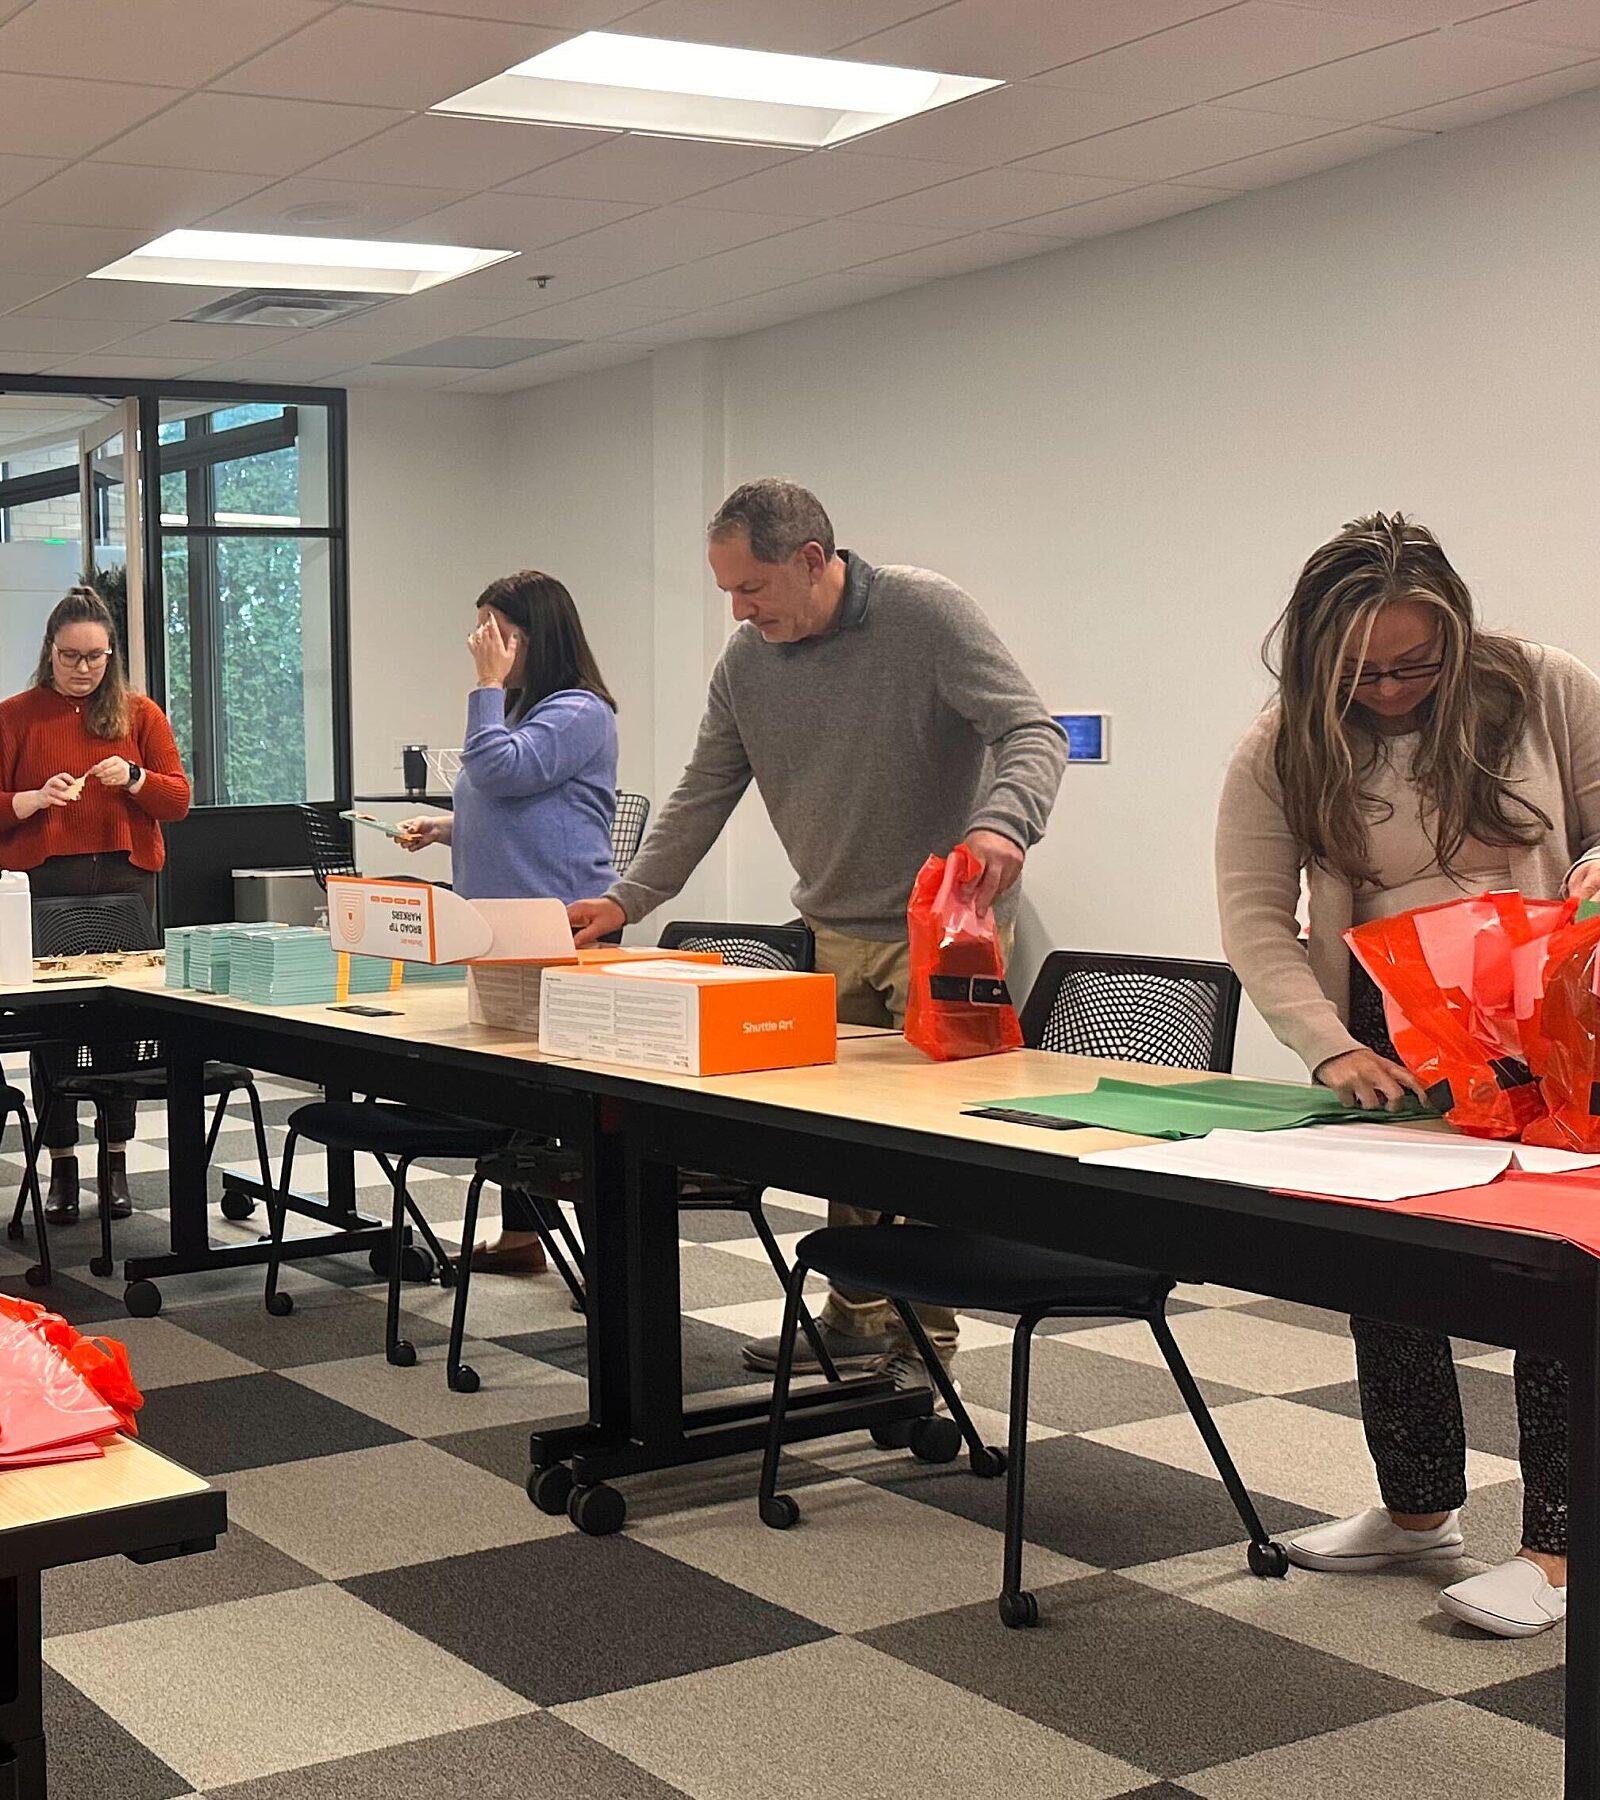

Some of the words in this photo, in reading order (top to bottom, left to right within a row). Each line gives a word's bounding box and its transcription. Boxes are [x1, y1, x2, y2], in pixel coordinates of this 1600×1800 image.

[391, 910, 422, 921] MARKERS
[389, 922, 399, 932] TIP
[400, 924, 422, 935] BROAD
[742, 1021, 778, 1034] Shuttle
[779, 1019, 794, 1031] Art
